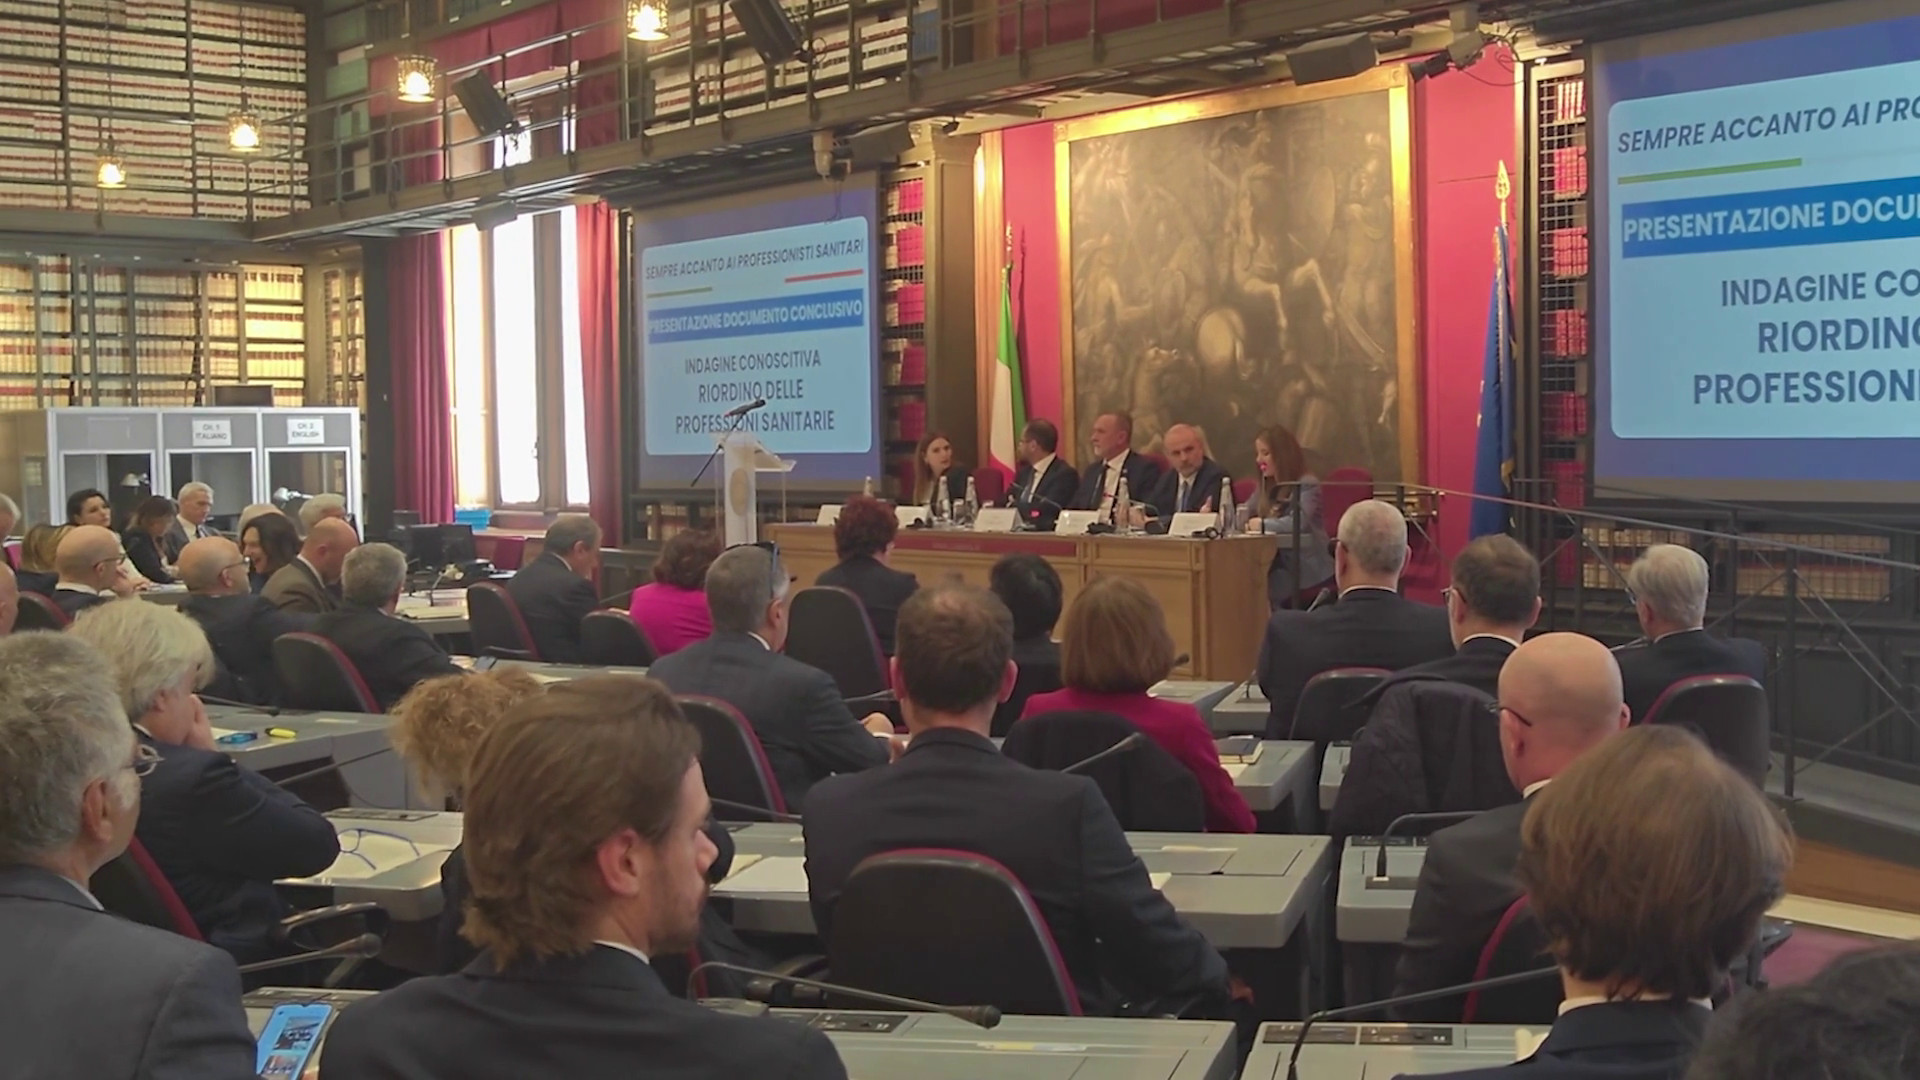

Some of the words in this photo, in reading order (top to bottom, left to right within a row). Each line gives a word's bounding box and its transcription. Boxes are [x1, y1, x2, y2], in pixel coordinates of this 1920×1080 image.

[1617, 123, 1706, 153] SEMPRE
[1710, 107, 1836, 143] ACCANTO
[1842, 101, 1870, 128] AI
[1623, 202, 1825, 243] PRESENTAZIONE
[1832, 194, 1920, 226] DOCU
[646, 263, 678, 280] SEMPRE
[680, 257, 724, 275] ACCANTO
[726, 256, 736, 270] AI
[738, 244, 814, 268] PROFESSIONISTI
[816, 239, 864, 258] SANITARI
[1721, 272, 1866, 306] INDAGINE
[1875, 269, 1920, 298] CO
[649, 313, 722, 335] PRESENTAZIONE
[723, 306, 788, 328] DOCUMENTO
[790, 299, 862, 322] CONCLUSIVO
[685, 355, 737, 375] INDAGINE
[739, 349, 821, 371] CONOSCITIVA
[699, 381, 762, 403] RIORDINO
[766, 379, 803, 400] DELLE
[1693, 369, 1920, 404] PROFESSION
[195, 432, 227, 440] ITALIANO
[291, 430, 320, 438] ENGLISH
[676, 412, 759, 434] PROFESSIONI
[761, 410, 835, 432] SANITARIE
